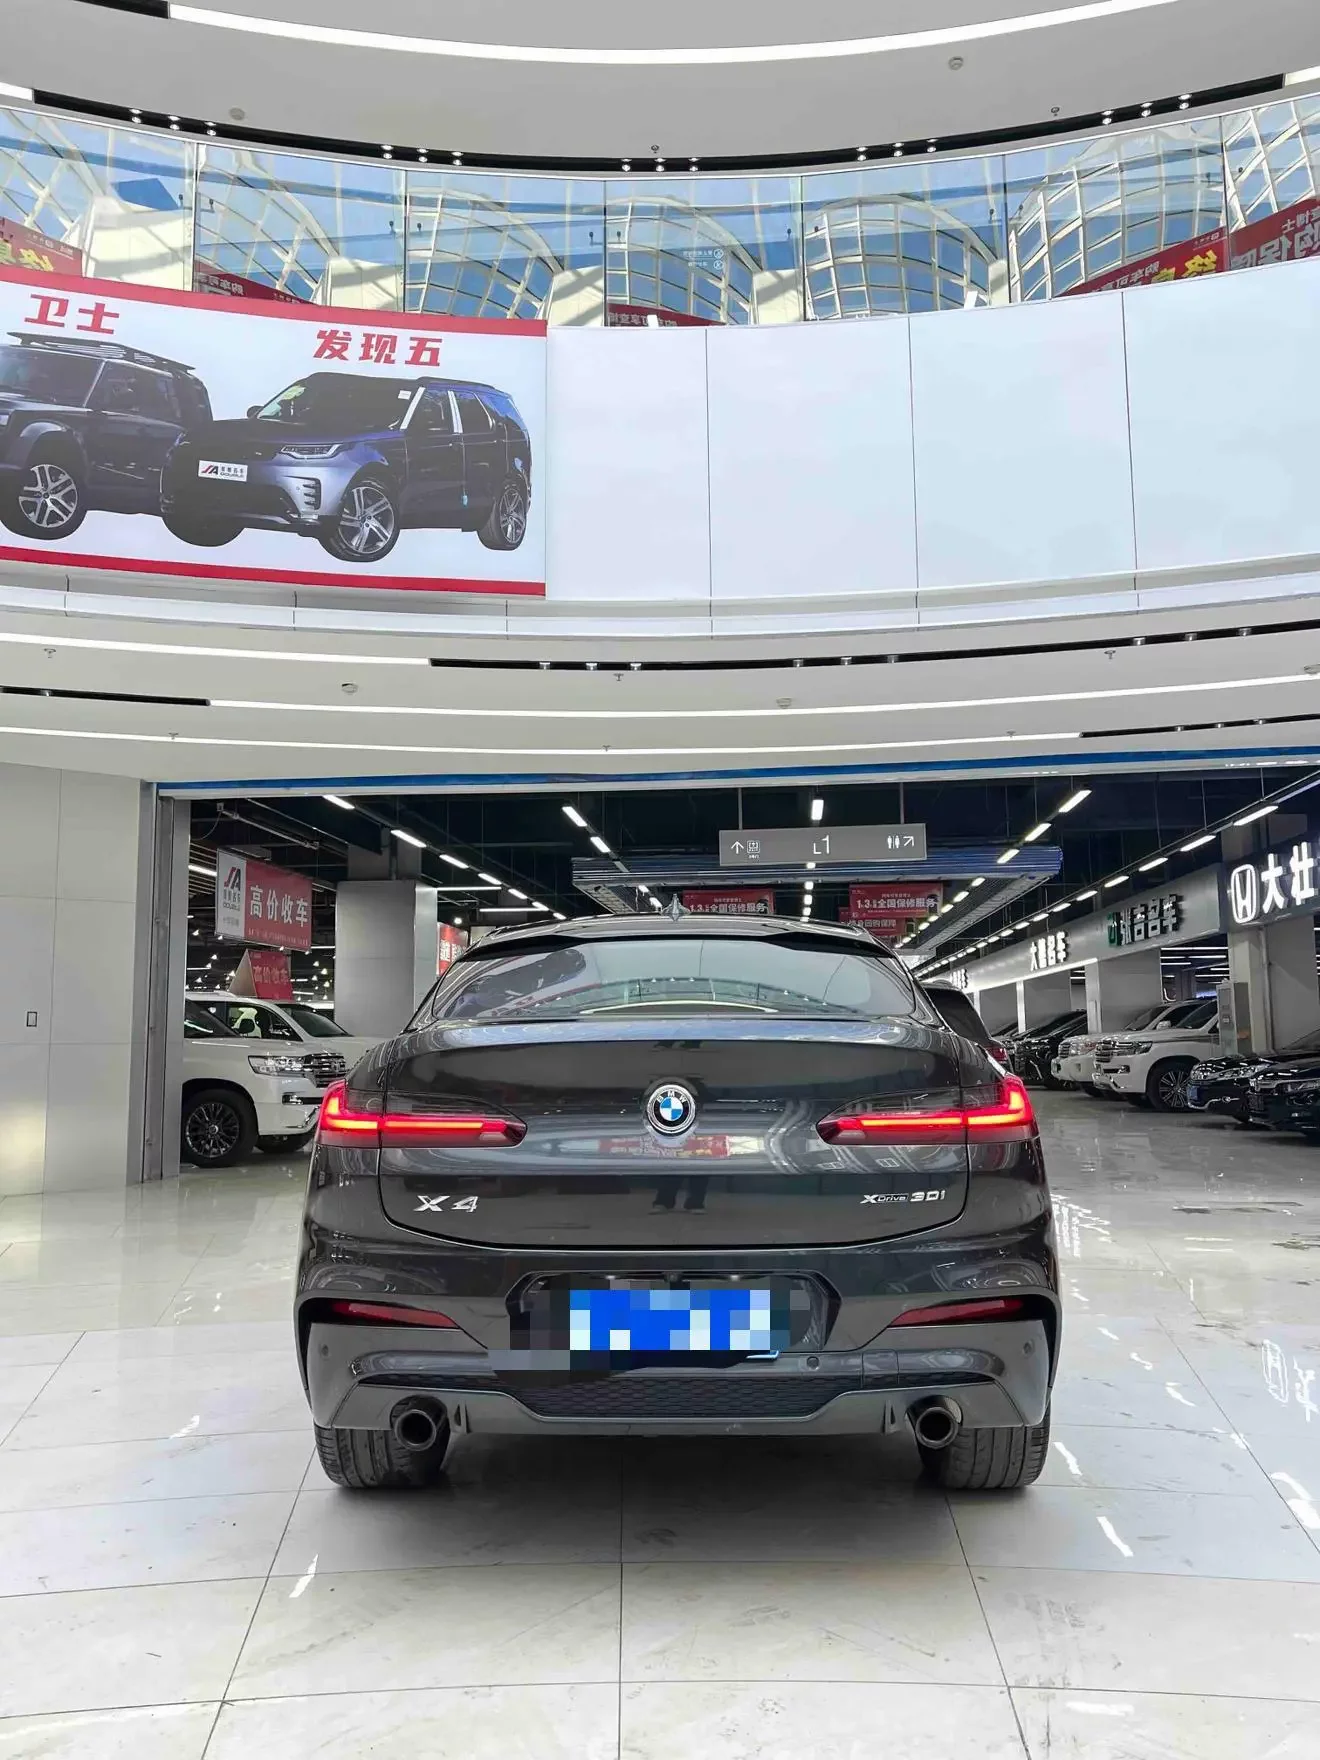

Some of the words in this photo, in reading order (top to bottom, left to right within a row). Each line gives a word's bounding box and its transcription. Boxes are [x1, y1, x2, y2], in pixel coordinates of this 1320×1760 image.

[24, 293, 120, 335] 卫士
[313, 329, 443, 367] 发现五
[813, 835, 830, 855] L1
[250, 885, 309, 928] 高价收车
